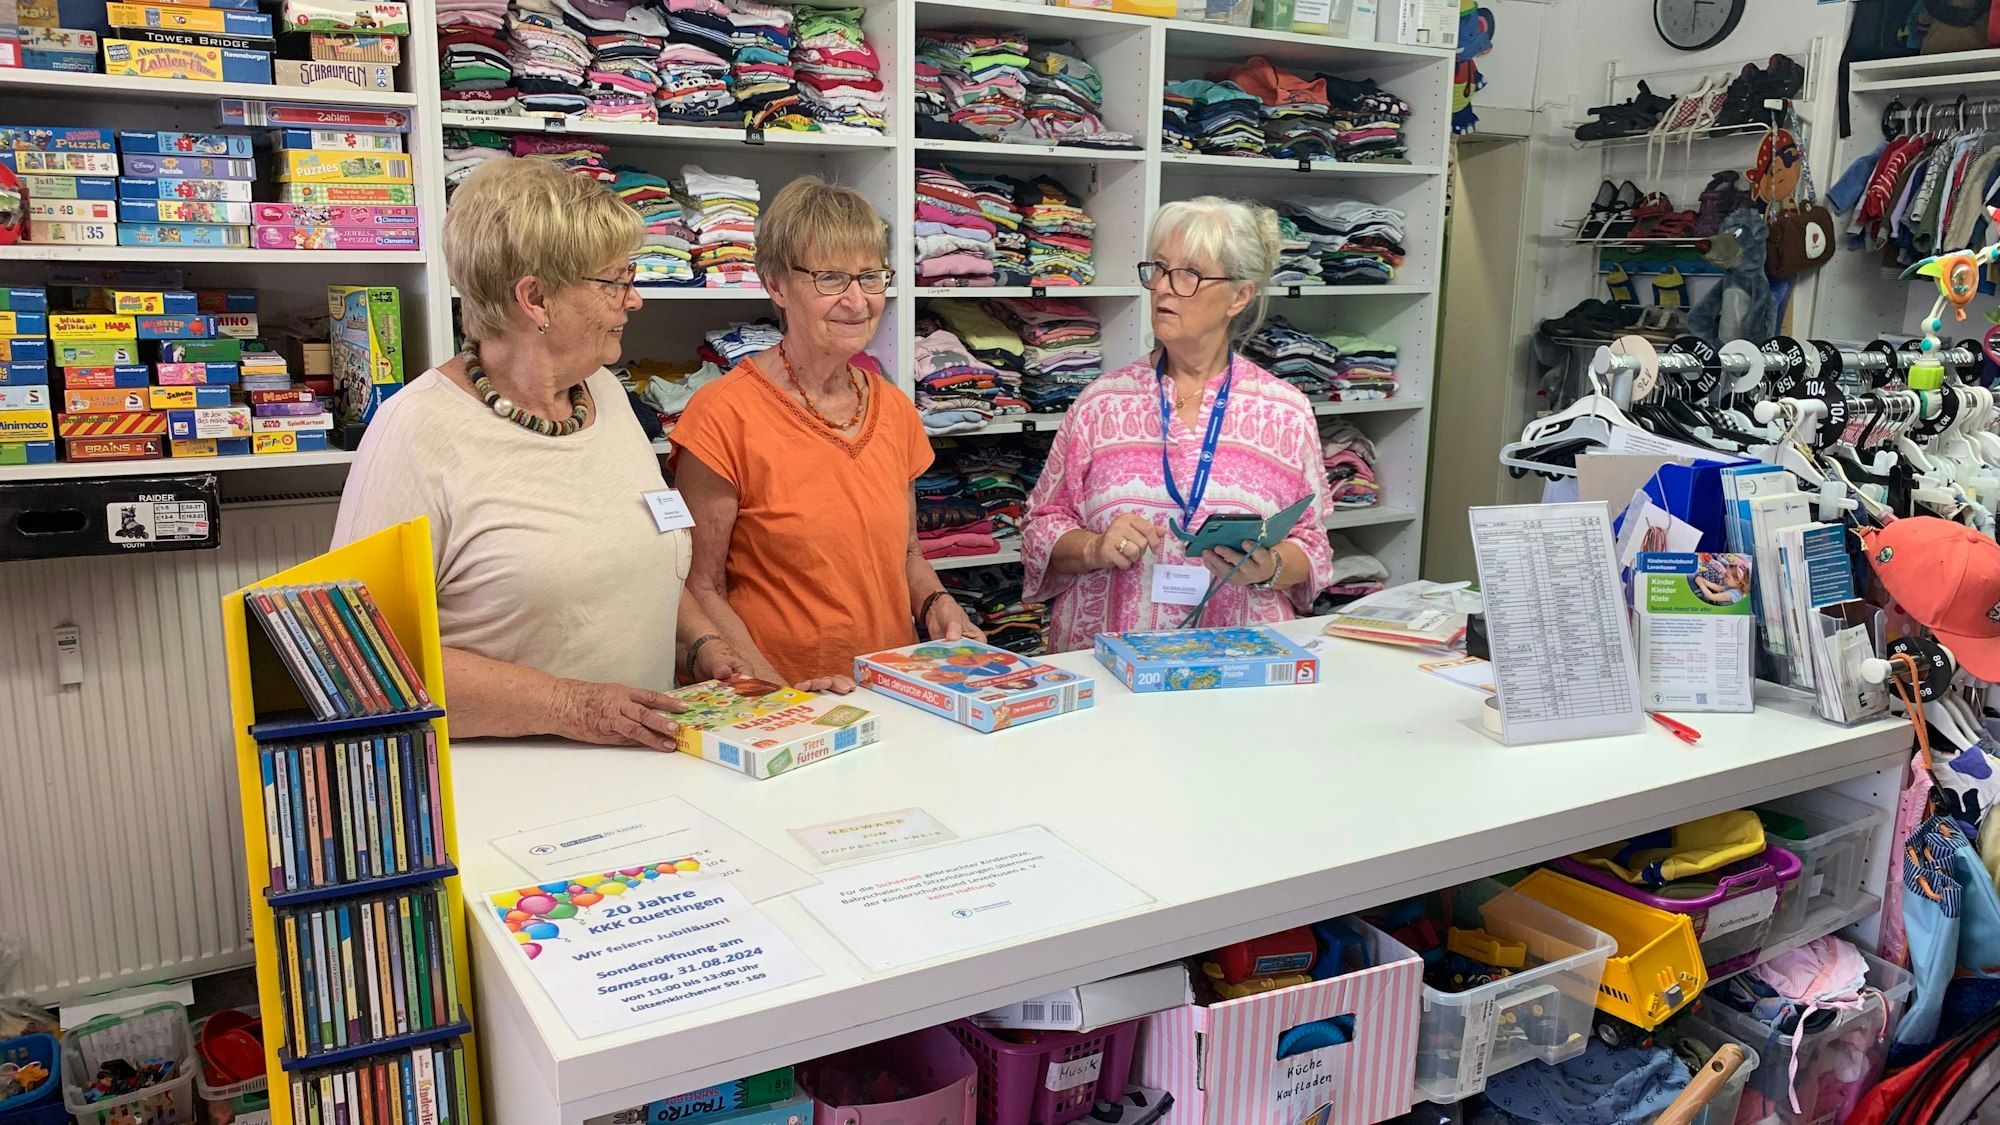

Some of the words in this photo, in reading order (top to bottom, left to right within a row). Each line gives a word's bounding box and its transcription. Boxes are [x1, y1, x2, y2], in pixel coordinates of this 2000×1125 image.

[227, 14, 268, 22] Ravensburger
[375, 5, 403, 17] HABA
[146, 32, 192, 44] TOWER
[200, 36, 249, 48] BRIDGE
[224, 52, 267, 60] Ravensburger
[52, 62, 94, 73] memory
[317, 112, 350, 122] Zahlen
[56, 139, 111, 150] Puzzle
[296, 163, 338, 178] Puzzles
[34, 177, 54, 186] 3x49
[60, 205, 74, 215] 48
[87, 226, 104, 240] 35
[104, 322, 132, 332] HABA
[1693, 340, 1715, 362] 170
[1787, 346, 1803, 367] 158
[1697, 372, 1717, 394] 170
[1777, 375, 1796, 394] 158
[1806, 381, 1826, 396] 104
[1830, 401, 1844, 425] 104
[85, 442, 130, 454] BRAINS
[138, 494, 175, 502] RAIDER
[1894, 643, 1907, 654] 86
[1223, 664, 1250, 672] Schmidt
[1932, 654, 1944, 668] 86
[1138, 672, 1160, 685] 200
[878, 674, 890, 688] Das
[892, 679, 922, 698] deutsche
[922, 687, 940, 705] ABC
[803, 738, 825, 752] Tiere
[828, 818, 905, 836] NEUWARE
[862, 831, 888, 839] ZUM
[820, 838, 898, 856] DOPPELTEN
[904, 832, 942, 842] PREIS
[705, 860, 718, 868] 10
[840, 888, 859, 897] Für
[861, 886, 874, 894] die
[876, 874, 922, 890] Sicherheit
[924, 864, 978, 879] gebrauchter
[979, 850, 1032, 868] Kindersitze,
[841, 888, 902, 905] Babyschalen
[904, 882, 922, 891] und
[924, 868, 994, 886] Sitzerhöhungen
[995, 855, 1045, 870] übernimmt
[882, 880, 967, 904] Kinderschutzbund
[968, 870, 1020, 885] Leverkusen
[928, 892, 953, 902] keine
[955, 881, 996, 896] Haftung!
[602, 903, 632, 918] 20
[636, 888, 697, 912] Jahre
[588, 919, 624, 935] KKK
[628, 895, 725, 925] Quettingen
[572, 948, 602, 963] Wir
[606, 936, 654, 954] feiern
[656, 916, 730, 941] Jubiläum!
[596, 944, 716, 980] Sonderöffnung
[720, 936, 744, 950] am
[596, 970, 674, 996] Samstag,
[678, 946, 764, 976] 31.08.2024
[620, 993, 645, 1004] von
[648, 982, 681, 998] 11:00
[683, 976, 700, 988] bis
[703, 968, 735, 984] 13:00
[737, 962, 760, 974] Uhr
[630, 984, 722, 1014] Lützenkirchener
[724, 980, 744, 992] Str.
[746, 972, 767, 985] 169
[1060, 1059, 1099, 1080] Musik
[1287, 1060, 1324, 1079] Küche
[1276, 1073, 1333, 1102] Kaufladen
[658, 1096, 726, 1122] TROTRO
